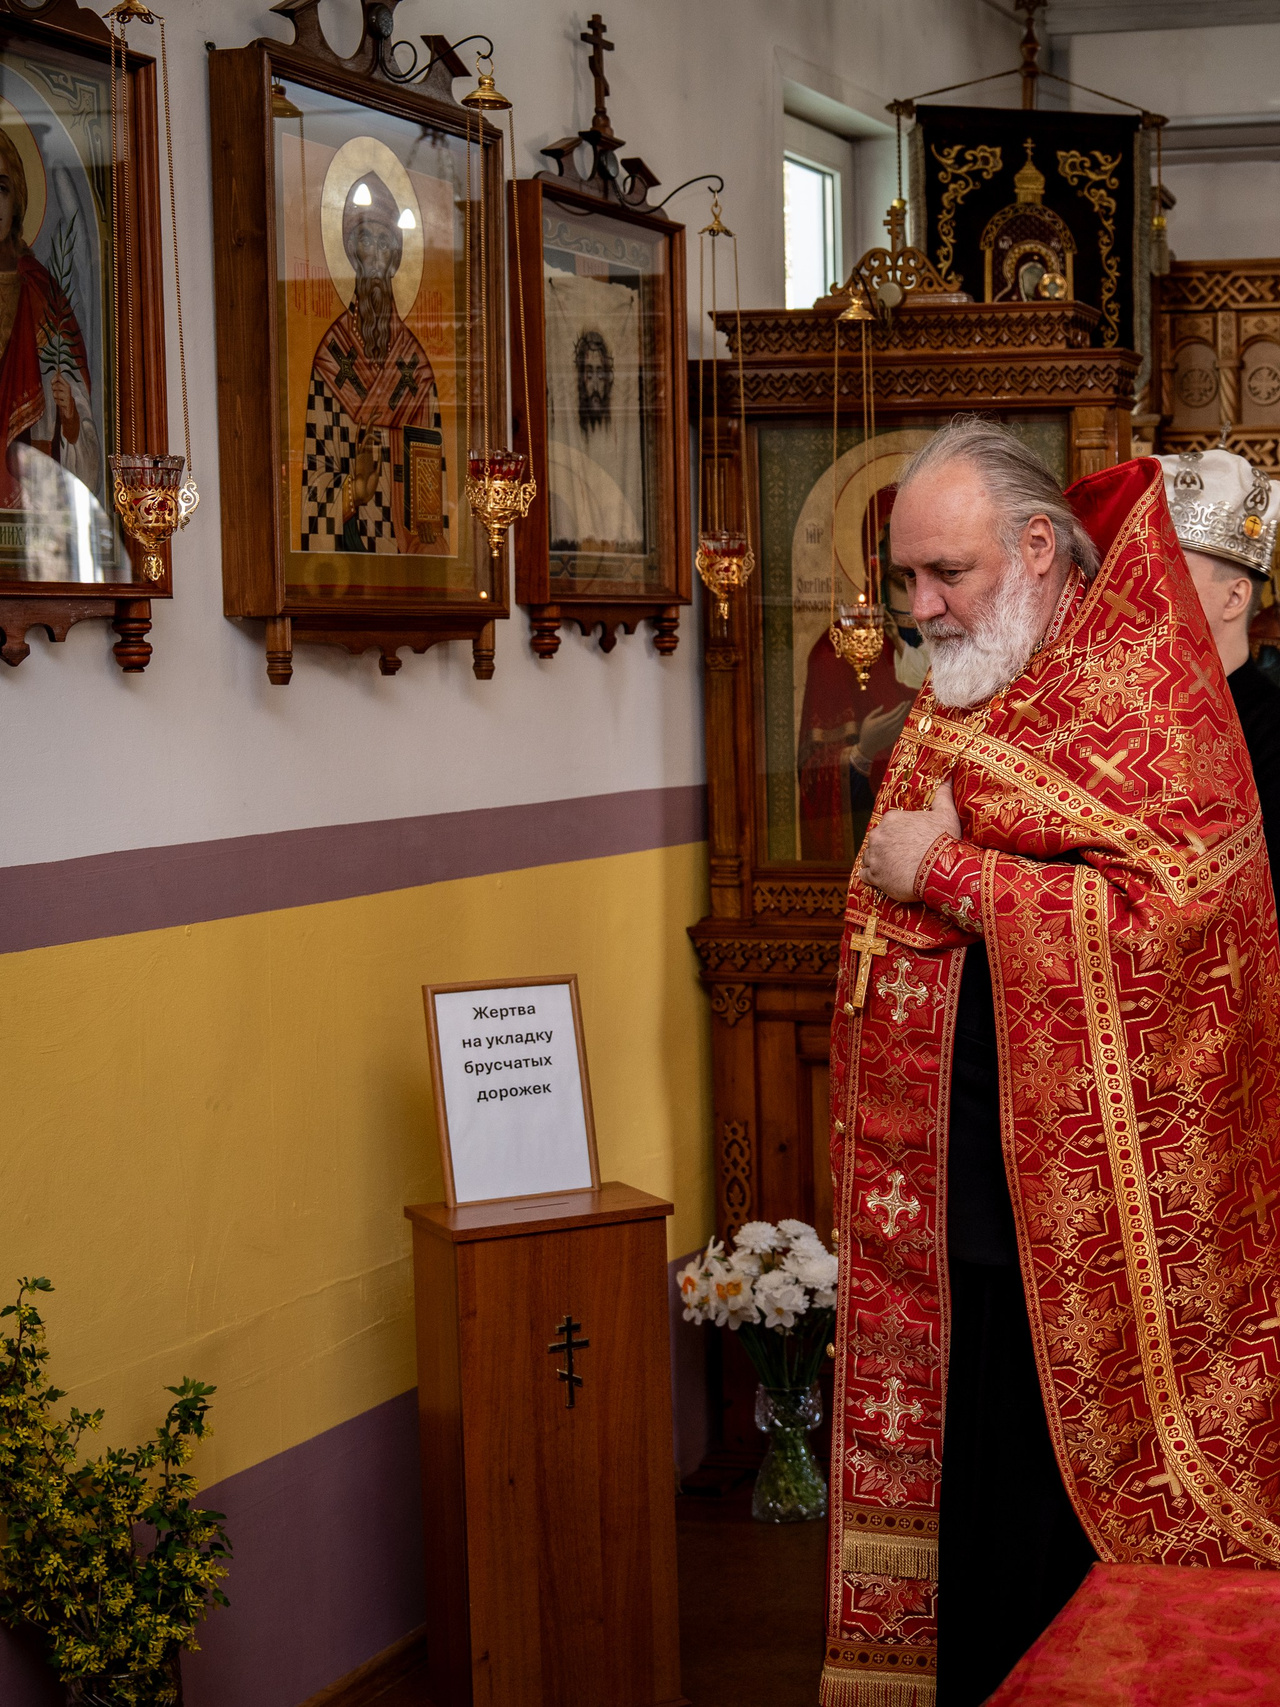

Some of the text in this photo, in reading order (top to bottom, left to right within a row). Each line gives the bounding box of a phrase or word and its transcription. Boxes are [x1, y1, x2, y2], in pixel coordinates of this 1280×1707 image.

[473, 1004, 535, 1020] Жертва
[462, 1030, 553, 1049] на укладку
[464, 1056, 552, 1076] брусчатых
[477, 1083, 552, 1102] дорожек
